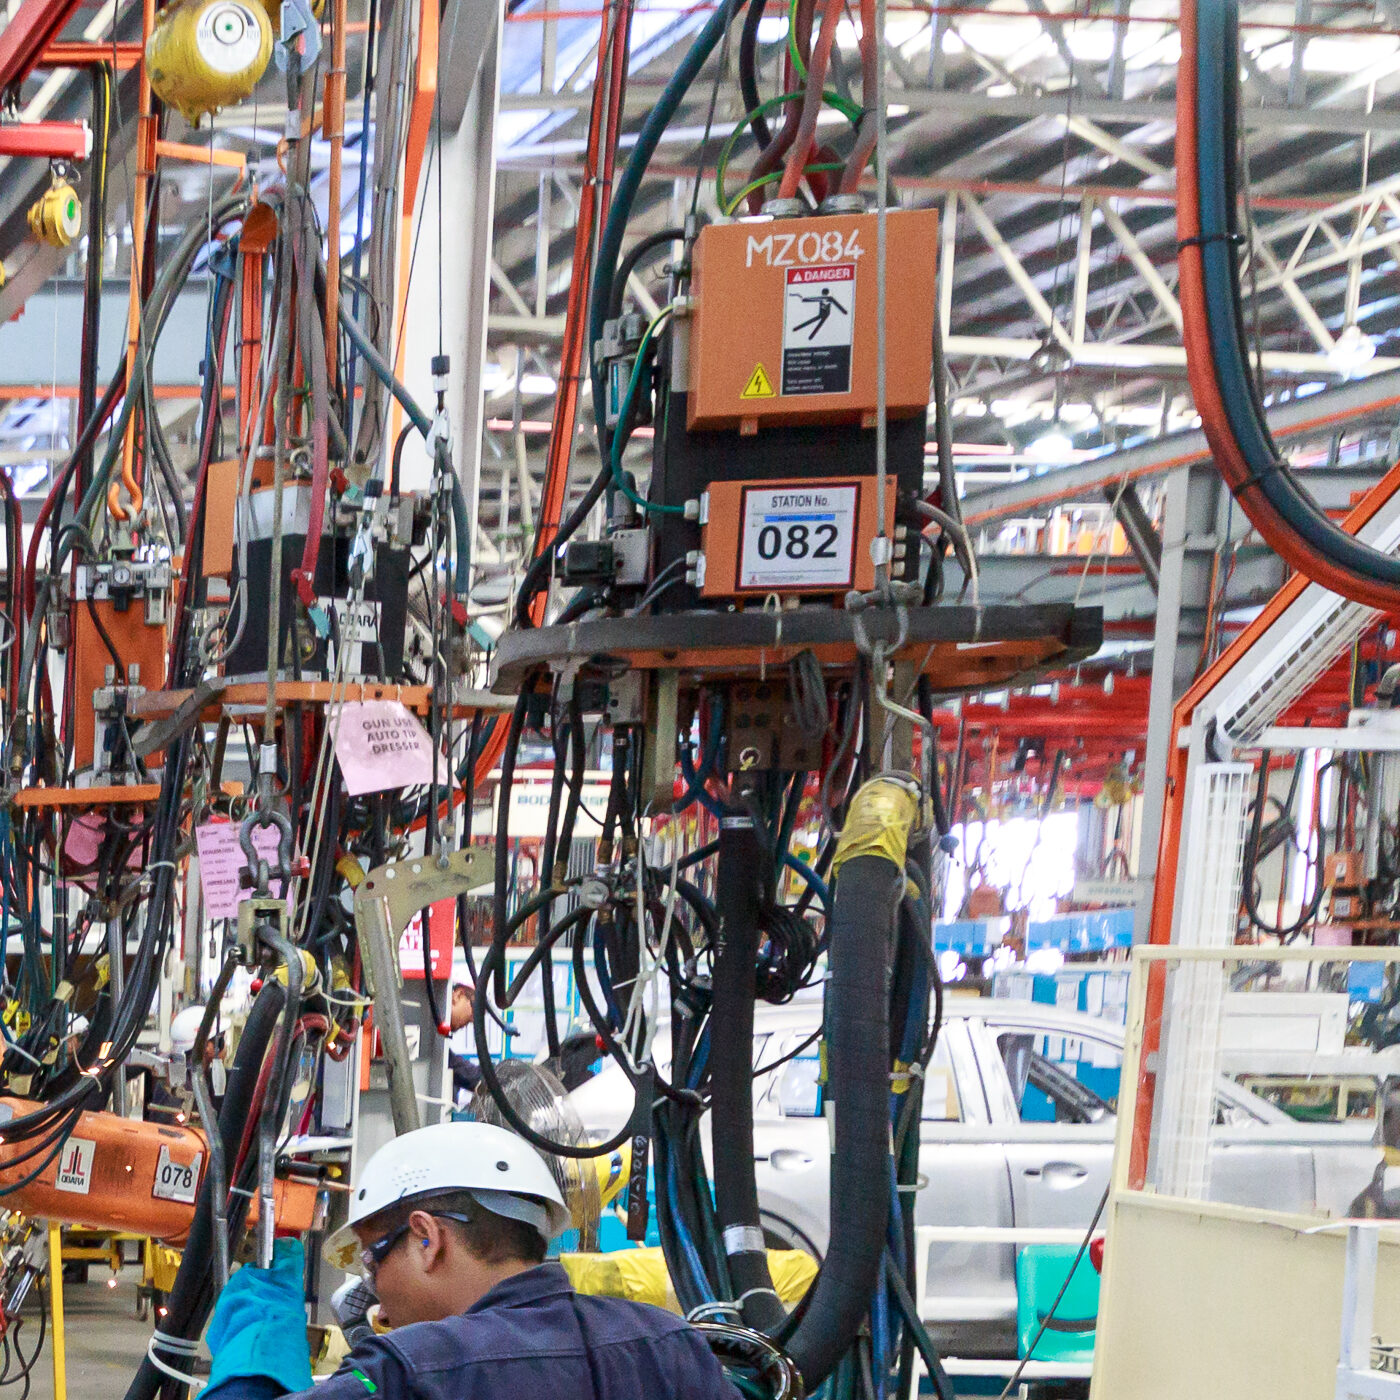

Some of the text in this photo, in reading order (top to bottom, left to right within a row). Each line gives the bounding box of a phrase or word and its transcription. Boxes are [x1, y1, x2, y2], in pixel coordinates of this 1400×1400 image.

[745, 228, 865, 268] MZ084
[804, 268, 850, 281] DANGER
[771, 495, 812, 508] STATION
[757, 524, 839, 560] 082
[362, 718, 391, 731] GUN
[367, 730, 400, 742] AUTO
[161, 1165, 193, 1188] 078
